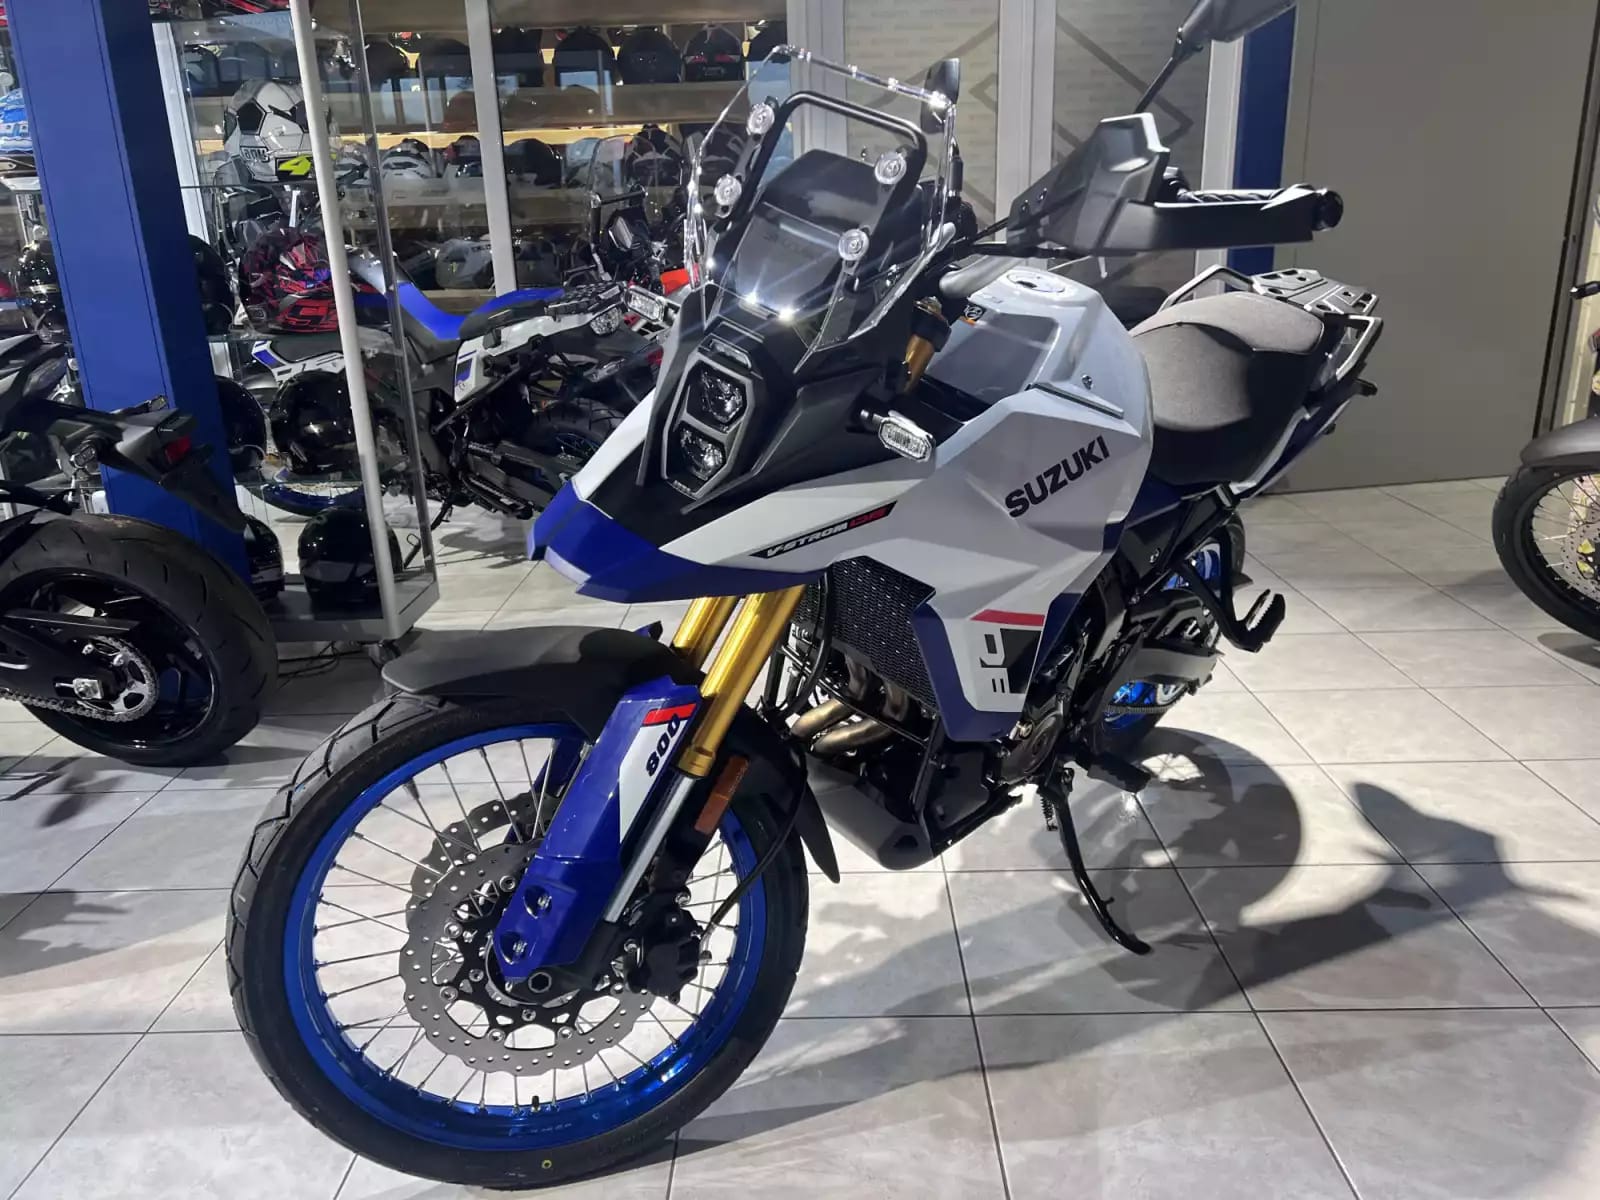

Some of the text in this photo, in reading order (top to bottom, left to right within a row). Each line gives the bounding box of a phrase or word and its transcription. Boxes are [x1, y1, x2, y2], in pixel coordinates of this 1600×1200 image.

[1005, 435, 1110, 518] SUZUKI
[767, 521, 848, 557] V-STROM
[646, 713, 680, 776] 800
